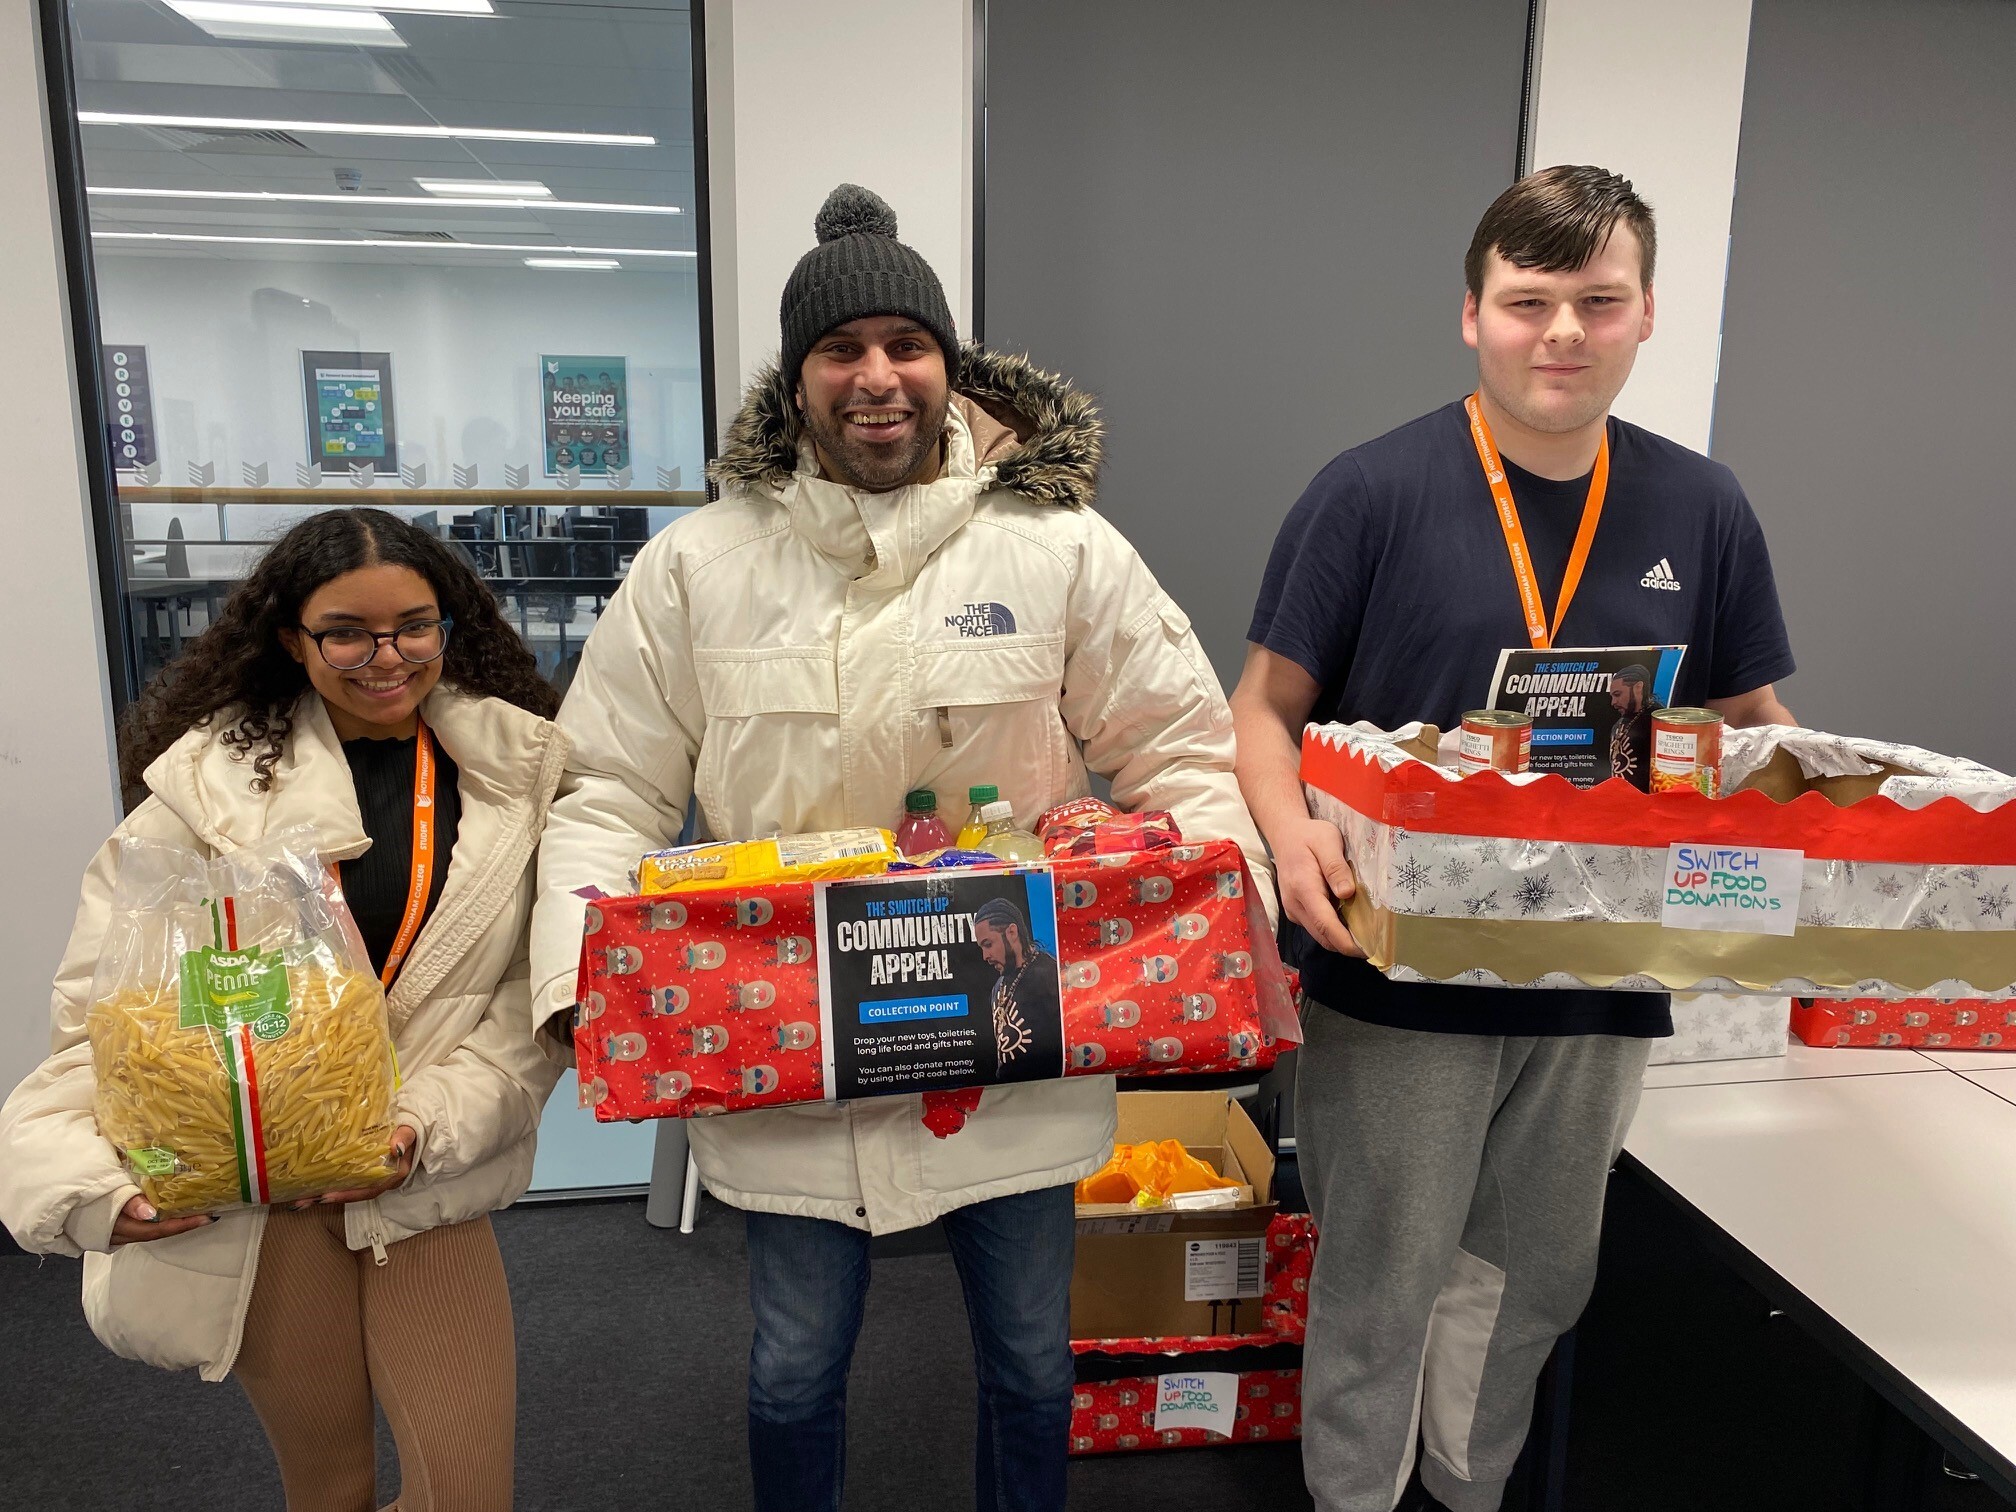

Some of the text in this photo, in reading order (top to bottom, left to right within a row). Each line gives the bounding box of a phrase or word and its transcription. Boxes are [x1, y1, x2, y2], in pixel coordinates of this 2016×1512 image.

[553, 391, 615, 407] Keeping
[553, 404, 616, 418] you safe
[1475, 425, 1497, 471] NOTTINGHAM
[1499, 497, 1514, 529] STUDENT
[1512, 542, 1538, 625] NOTTINGHAM COLLEGE
[1640, 577, 1681, 591] adidas
[963, 603, 990, 615] THE
[944, 614, 991, 627] NORTH
[959, 625, 993, 637] FACE
[1534, 662, 1599, 673] THE SWITCH UP
[1505, 673, 1617, 694] COMMUNITY
[1524, 696, 1587, 718] APPEAL
[1657, 740, 1694, 750] SPAGHETTI
[1663, 747, 1685, 756] RINGS
[420, 749, 429, 795] NOTTINGHAM
[1564, 761, 1579, 769] gifts
[420, 820, 428, 850] STUDENT
[1677, 848, 1759, 871] SWITCH
[1674, 871, 1767, 892] UP FOOD
[866, 896, 950, 917] THE SWITCH UP
[1665, 888, 1781, 910] DONATIONS
[394, 863, 426, 954] NOTTINGHAM COLLEGE
[837, 913, 978, 952] COMMUNITY
[209, 953, 250, 967] ASDA
[870, 950, 953, 985] APPEAL
[206, 968, 260, 991] PENNE
[868, 1002, 960, 1017] COLLECTION POINT
[256, 1019, 287, 1033] 10-12
[260, 1028, 286, 1039] MINUTES
[853, 1037, 876, 1046] Drop
[876, 1034, 896, 1044] your
[917, 1031, 937, 1040] toys,
[938, 1028, 977, 1038] toiletries,
[857, 1038, 974, 1055] long life food and gifts here.
[858, 1059, 975, 1074] You can also donate money
[857, 1067, 977, 1085] by using the QR code below.
[1164, 1378, 1205, 1390] SWITCH
[1164, 1390, 1213, 1402] UP FOOD
[1160, 1401, 1219, 1413] DONATIONS
